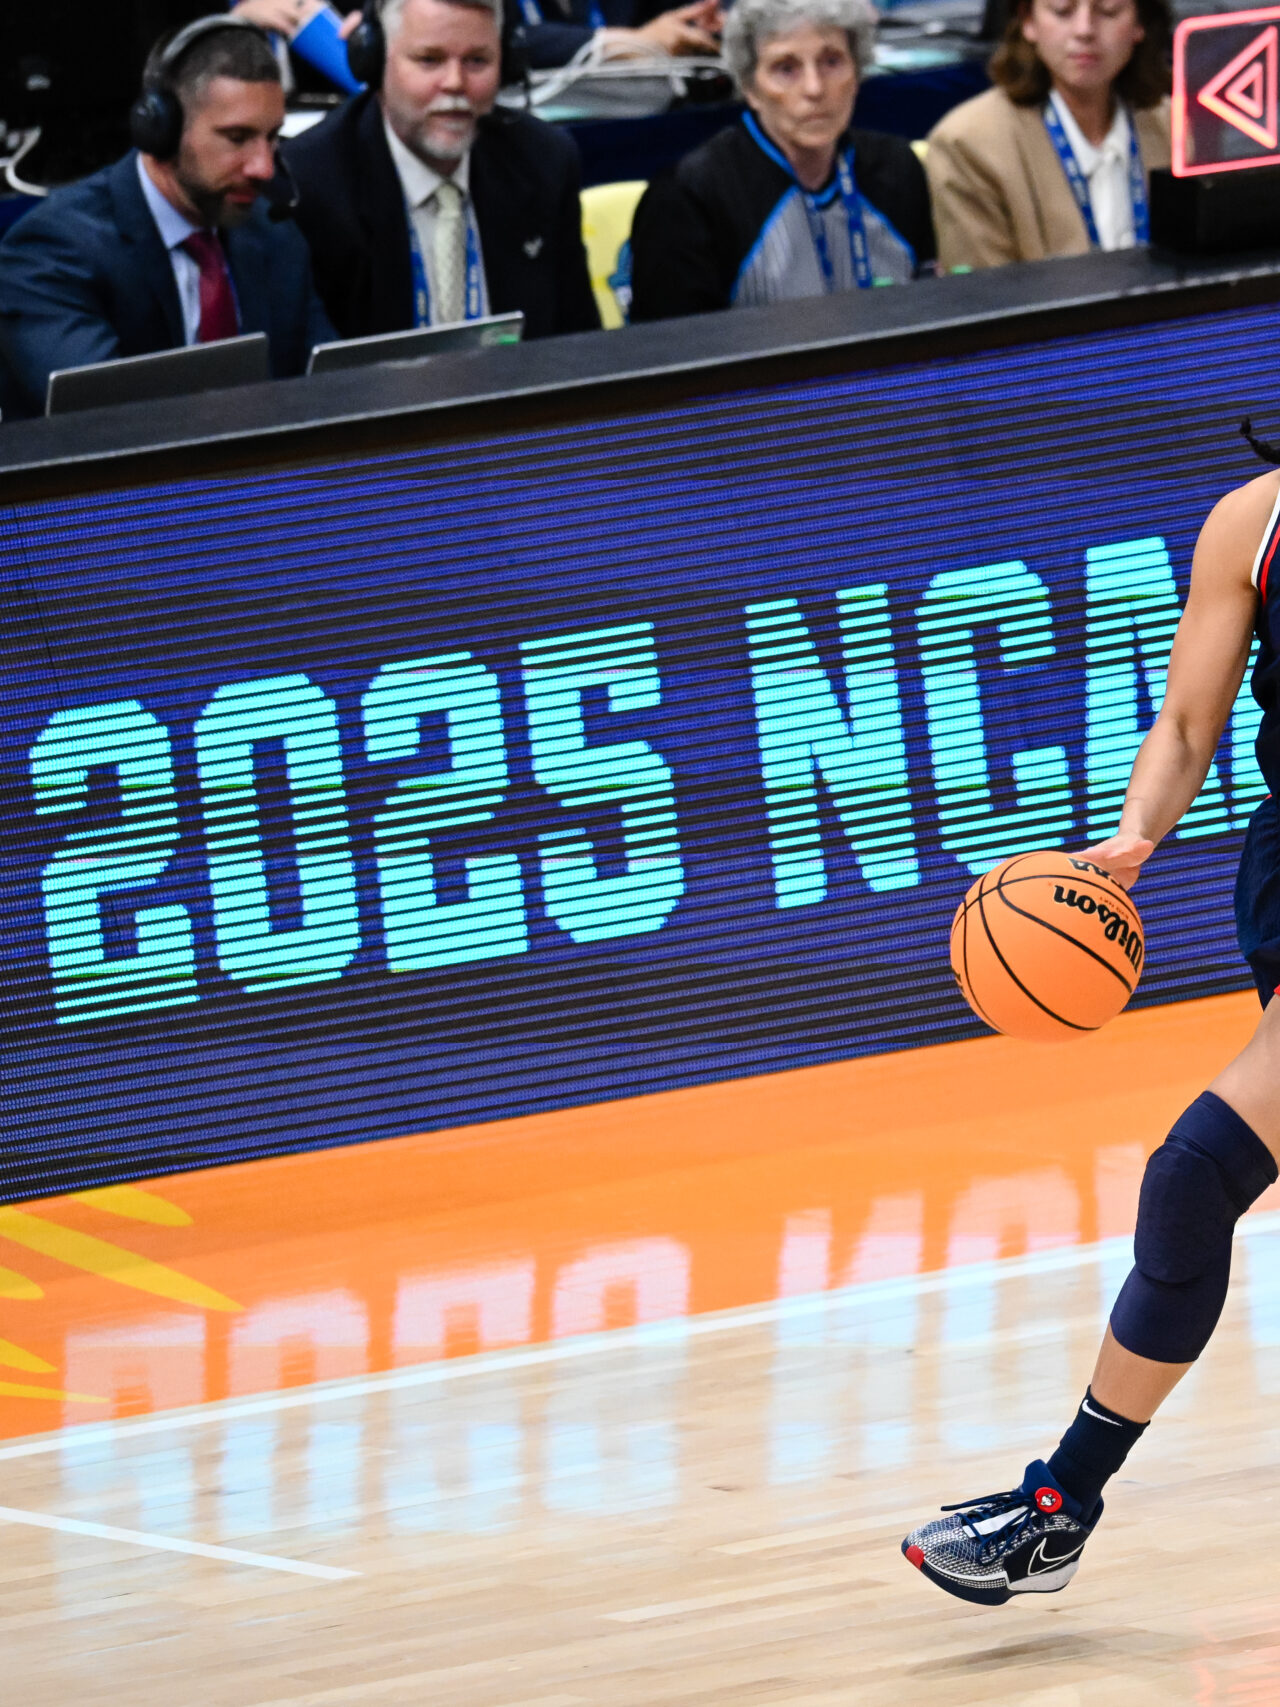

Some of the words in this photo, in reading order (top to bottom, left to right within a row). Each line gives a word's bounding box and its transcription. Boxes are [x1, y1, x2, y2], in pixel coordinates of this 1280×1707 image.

[29, 622, 684, 1025] 2025
[744, 536, 1270, 909] NCA
[1053, 884, 1143, 974] Wilson
